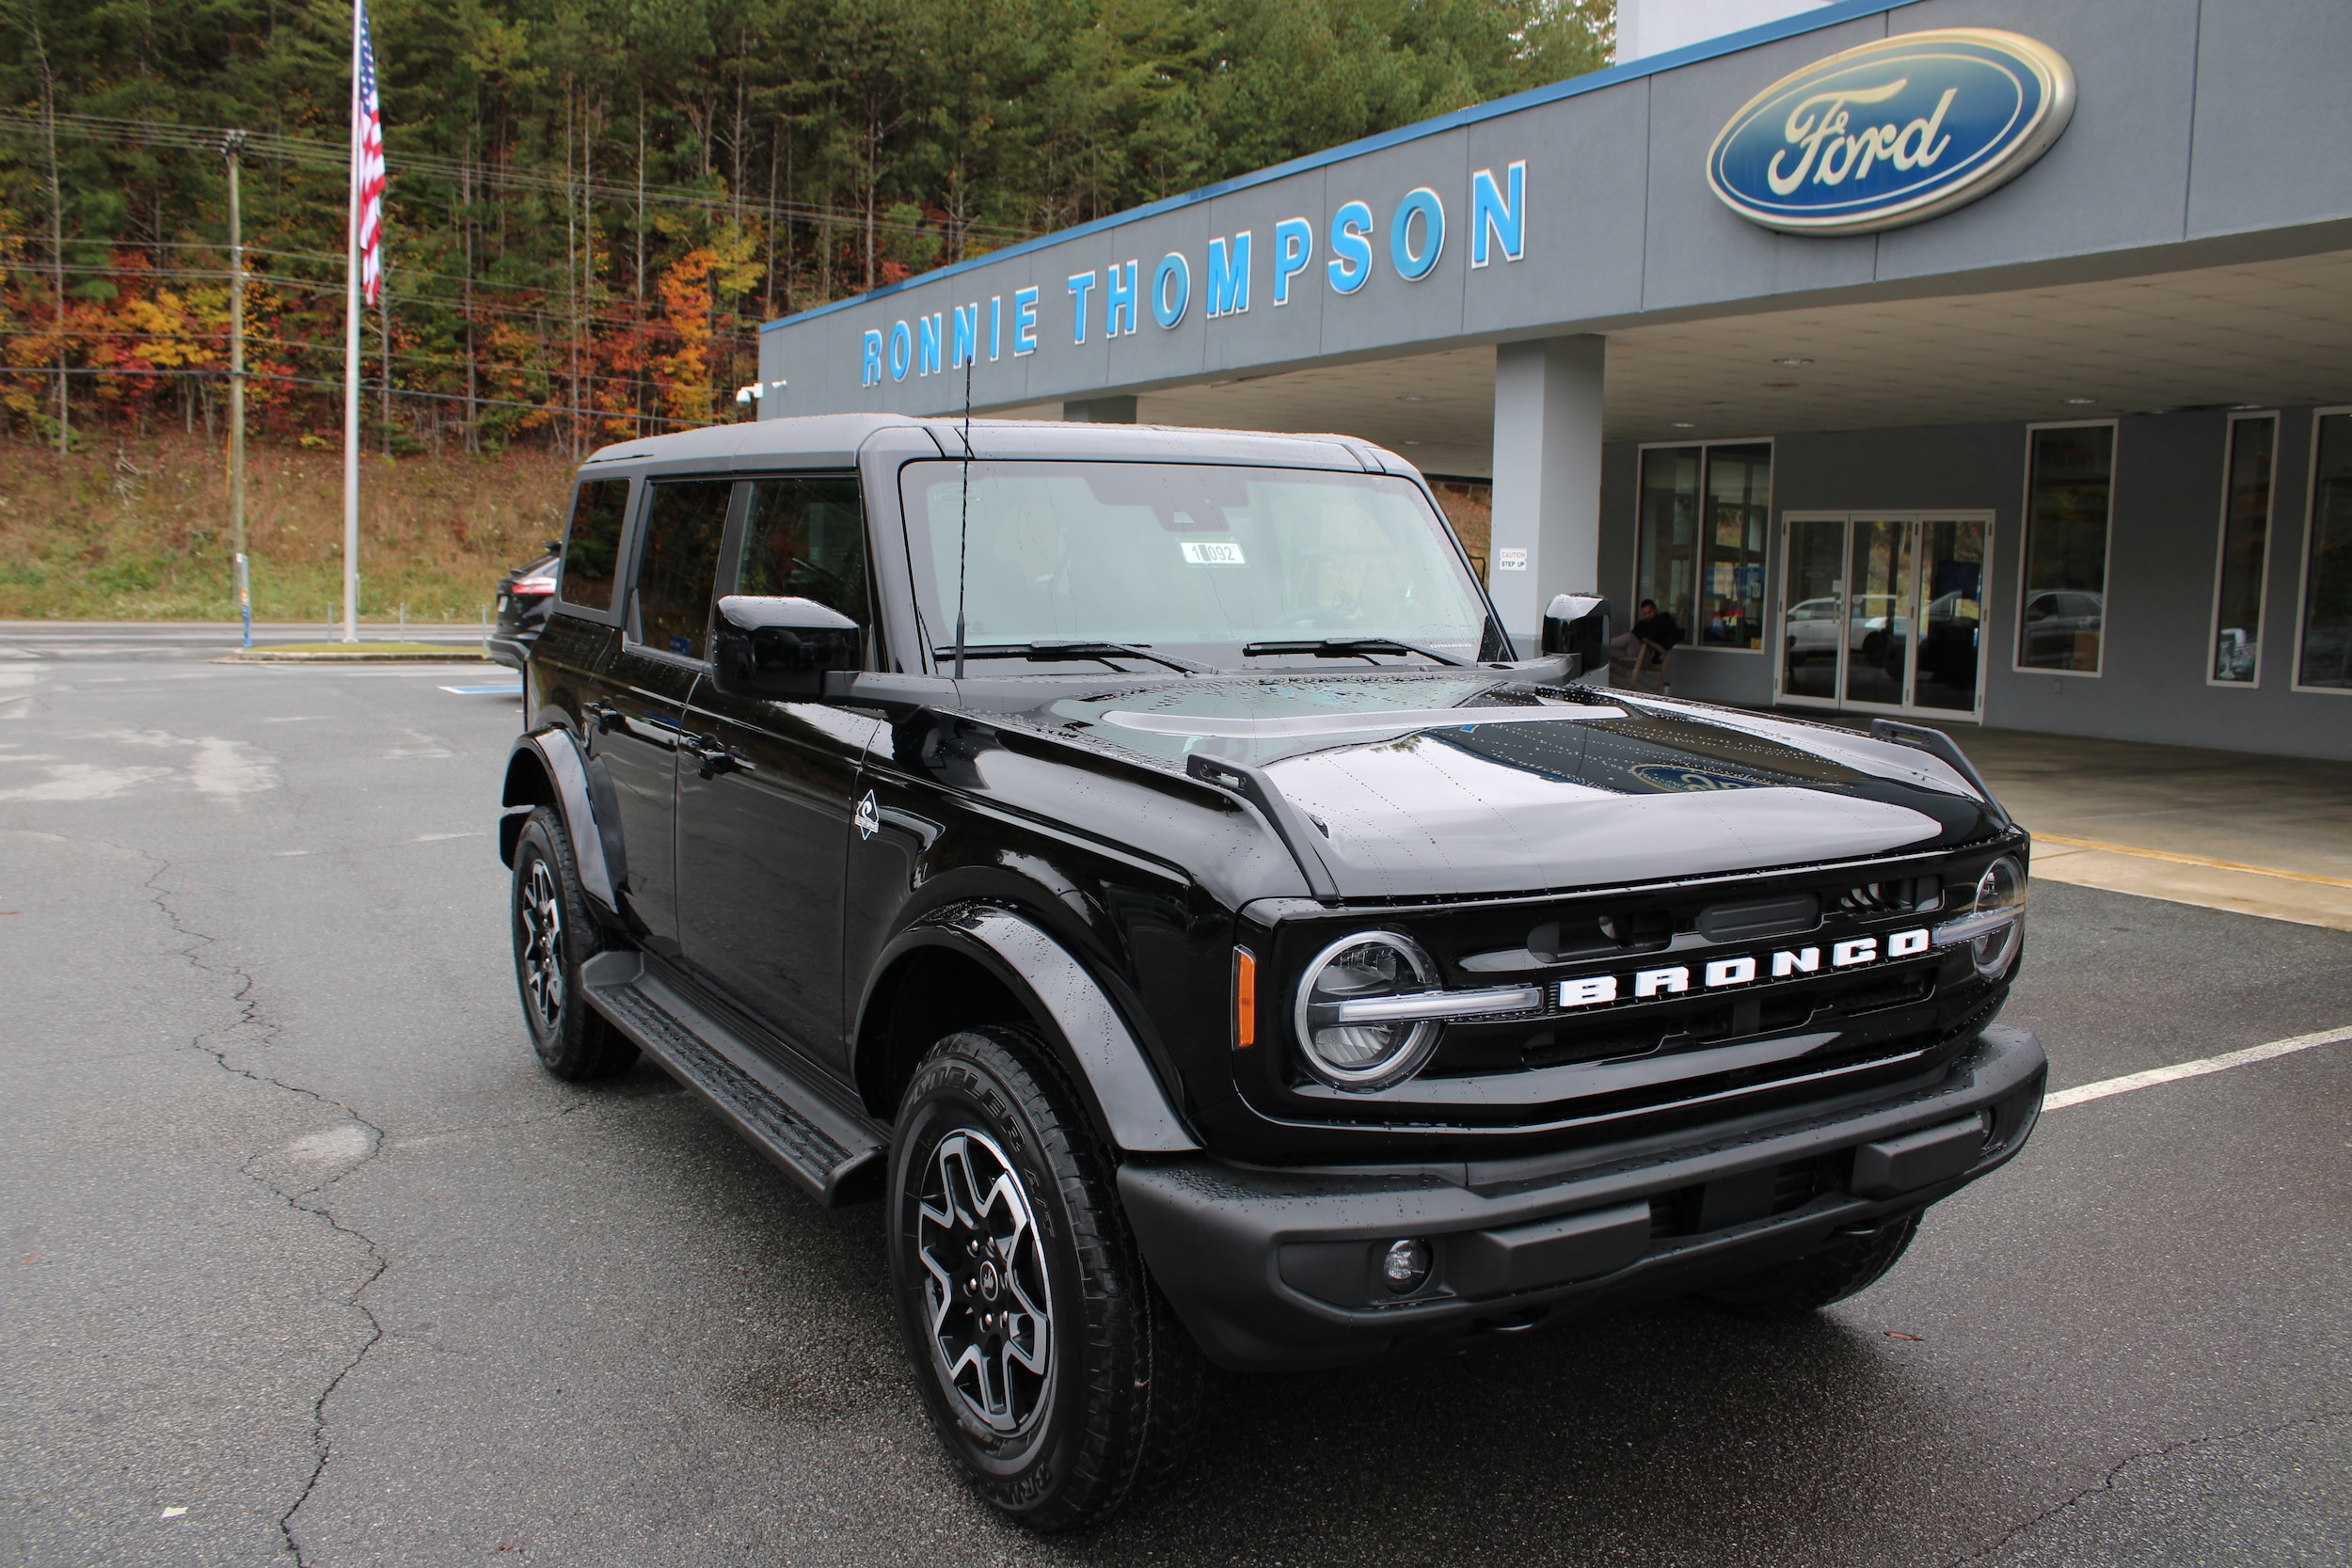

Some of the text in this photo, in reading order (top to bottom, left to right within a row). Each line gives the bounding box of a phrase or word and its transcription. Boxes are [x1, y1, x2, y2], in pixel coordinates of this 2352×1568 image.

[1768, 78, 1958, 196] Ford
[862, 158, 1527, 388] RONNIE THOMPSON
[1191, 544, 1235, 562] 1092
[1502, 550, 1526, 559] CAUTION
[1558, 927, 1930, 1007] BRONCO
[912, 1065, 1026, 1153] DUELER
